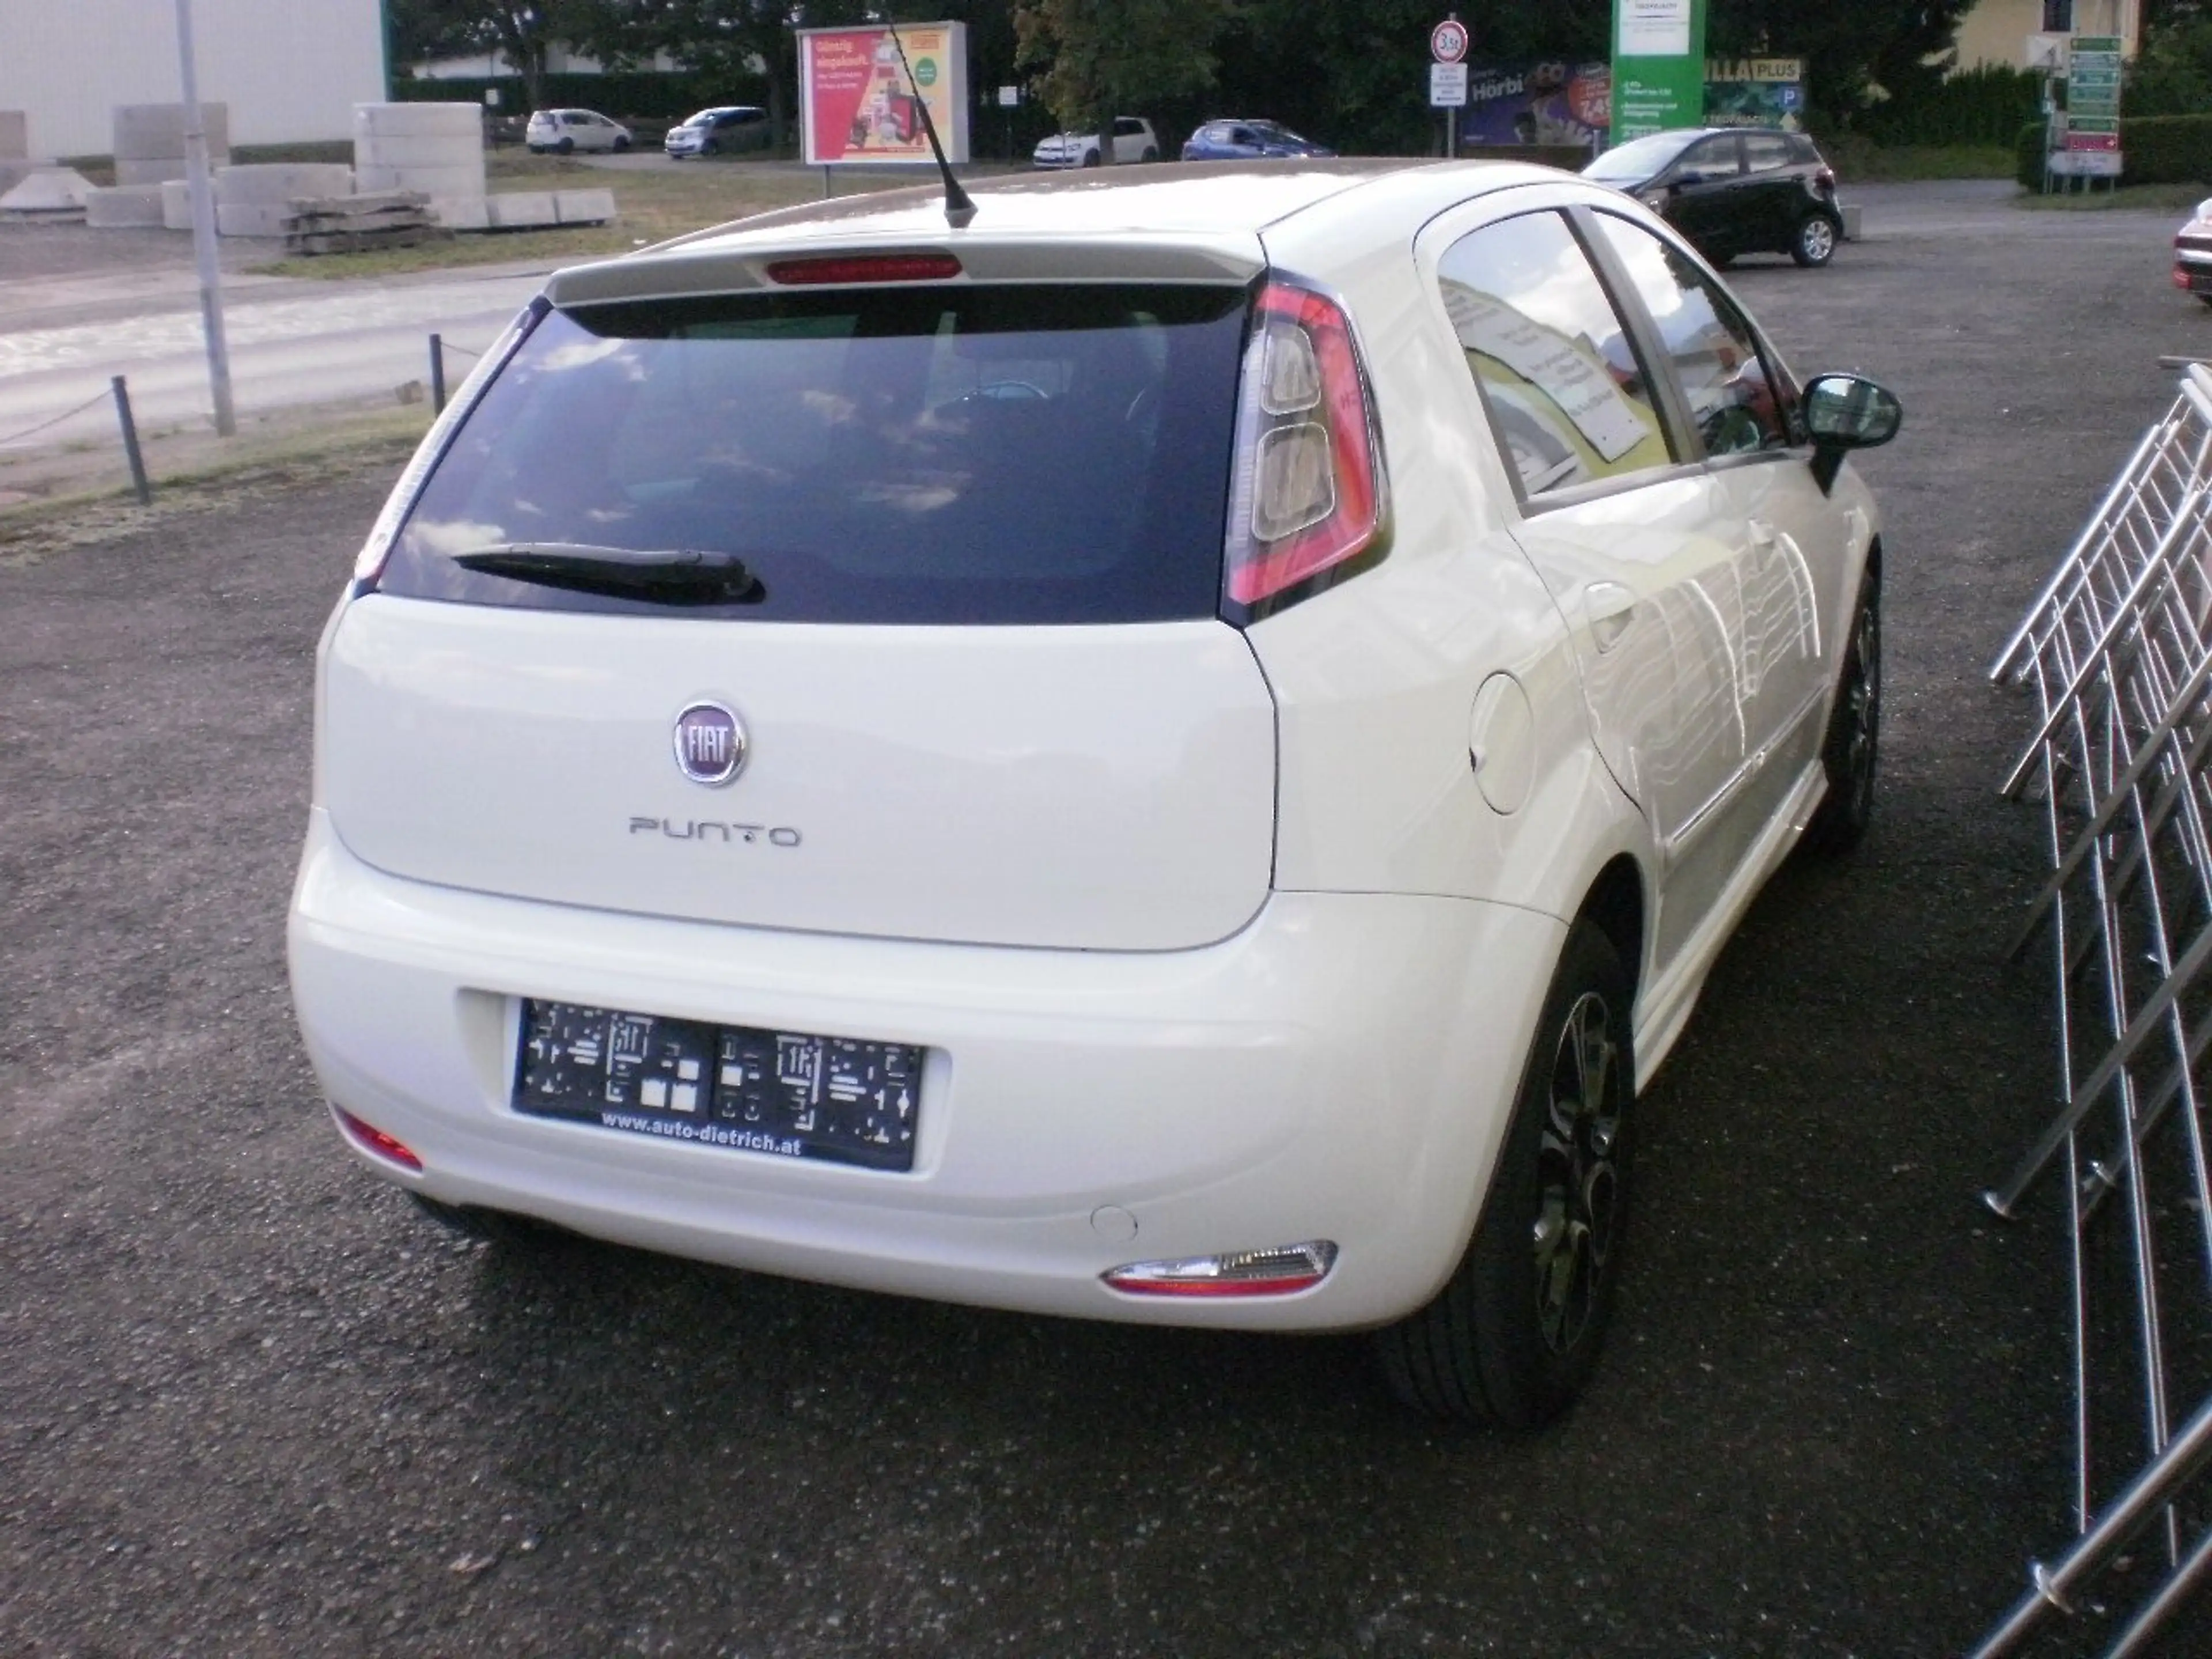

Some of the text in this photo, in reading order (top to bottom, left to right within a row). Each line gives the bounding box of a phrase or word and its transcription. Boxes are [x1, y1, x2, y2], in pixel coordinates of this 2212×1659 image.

[1758, 63, 1797, 77] PLUS
[1472, 73, 1524, 101] Hörbi
[1783, 89, 1796, 105] P
[688, 726, 729, 762] FIAT
[629, 817, 802, 847] PUNTO
[601, 1112, 802, 1156] www.auto-dietrich.at
